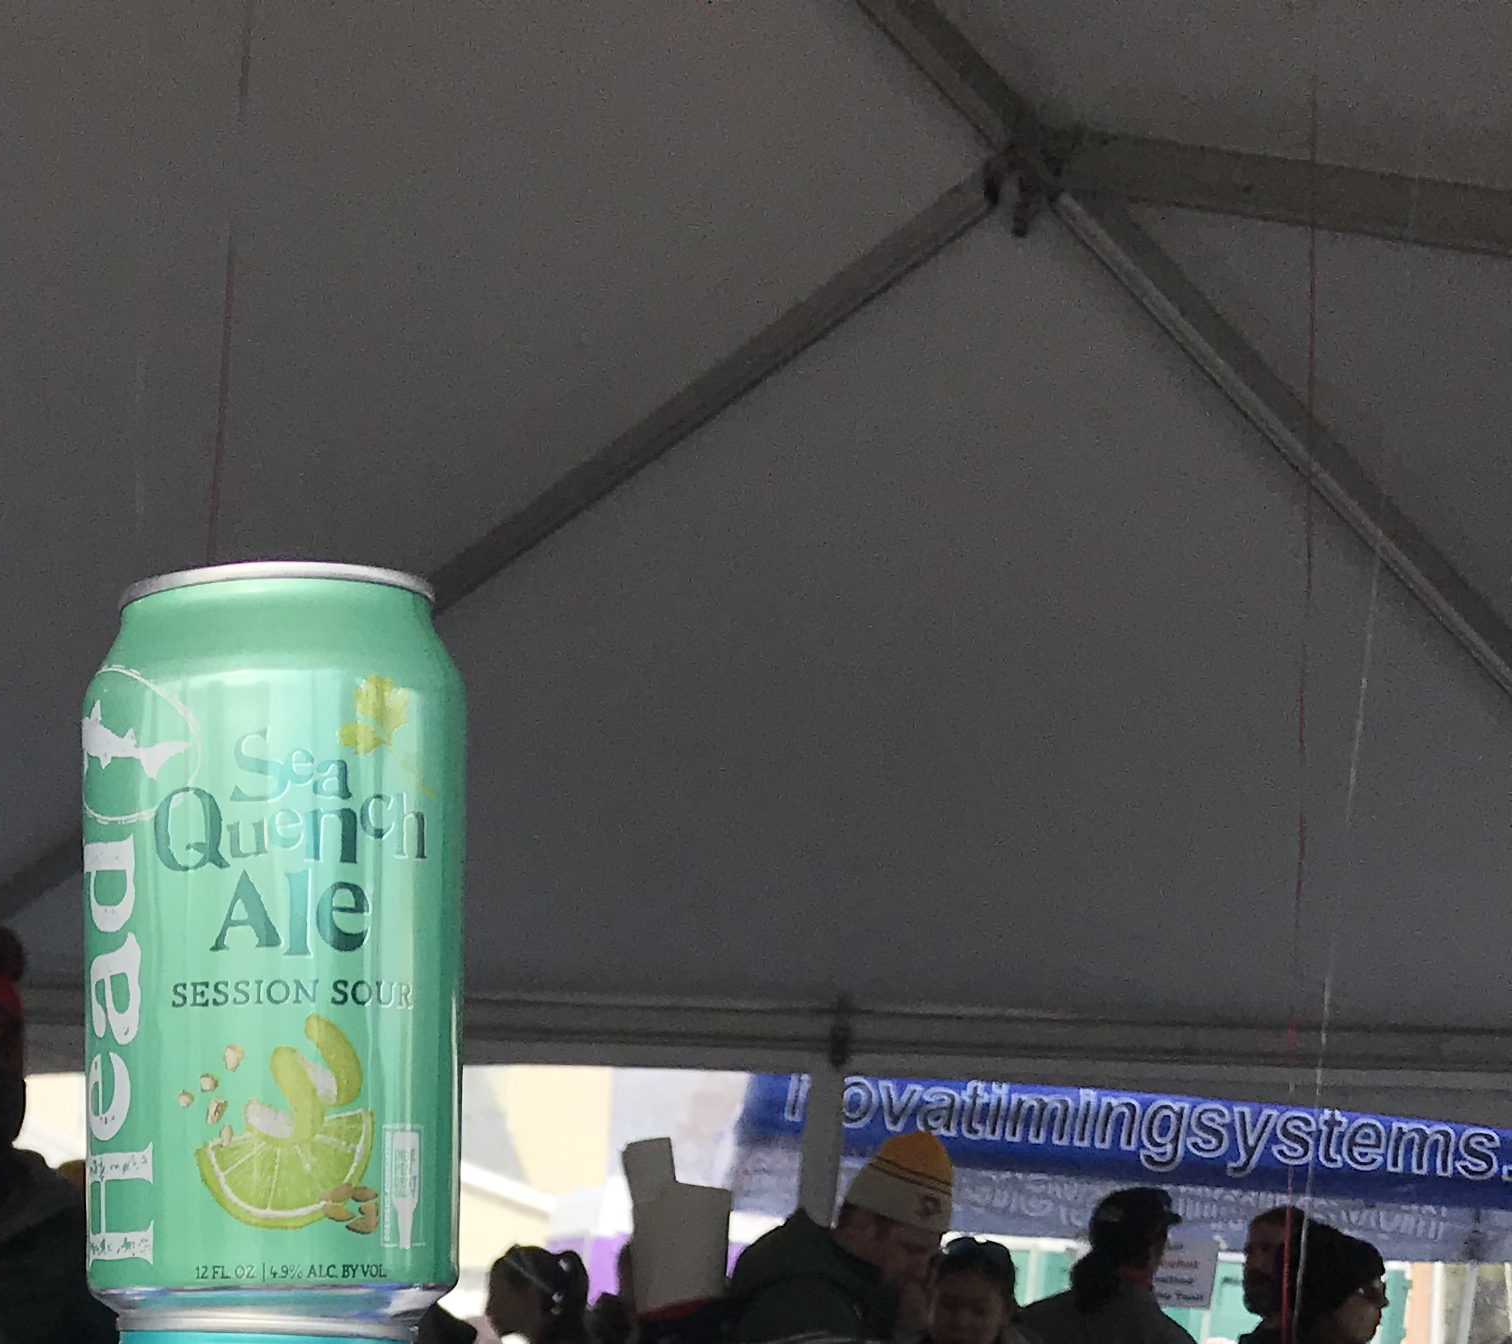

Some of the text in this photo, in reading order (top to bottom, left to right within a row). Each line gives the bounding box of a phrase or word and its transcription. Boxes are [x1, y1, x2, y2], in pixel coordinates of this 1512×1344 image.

[229, 726, 352, 803] Sea
[154, 787, 427, 872] Quench
[209, 867, 372, 958] Ale
[171, 978, 414, 1010] SESSION SOUR
[195, 1264, 208, 1280] 12
[269, 1263, 304, 1281] 4.9%
[342, 1264, 360, 1280] BY
